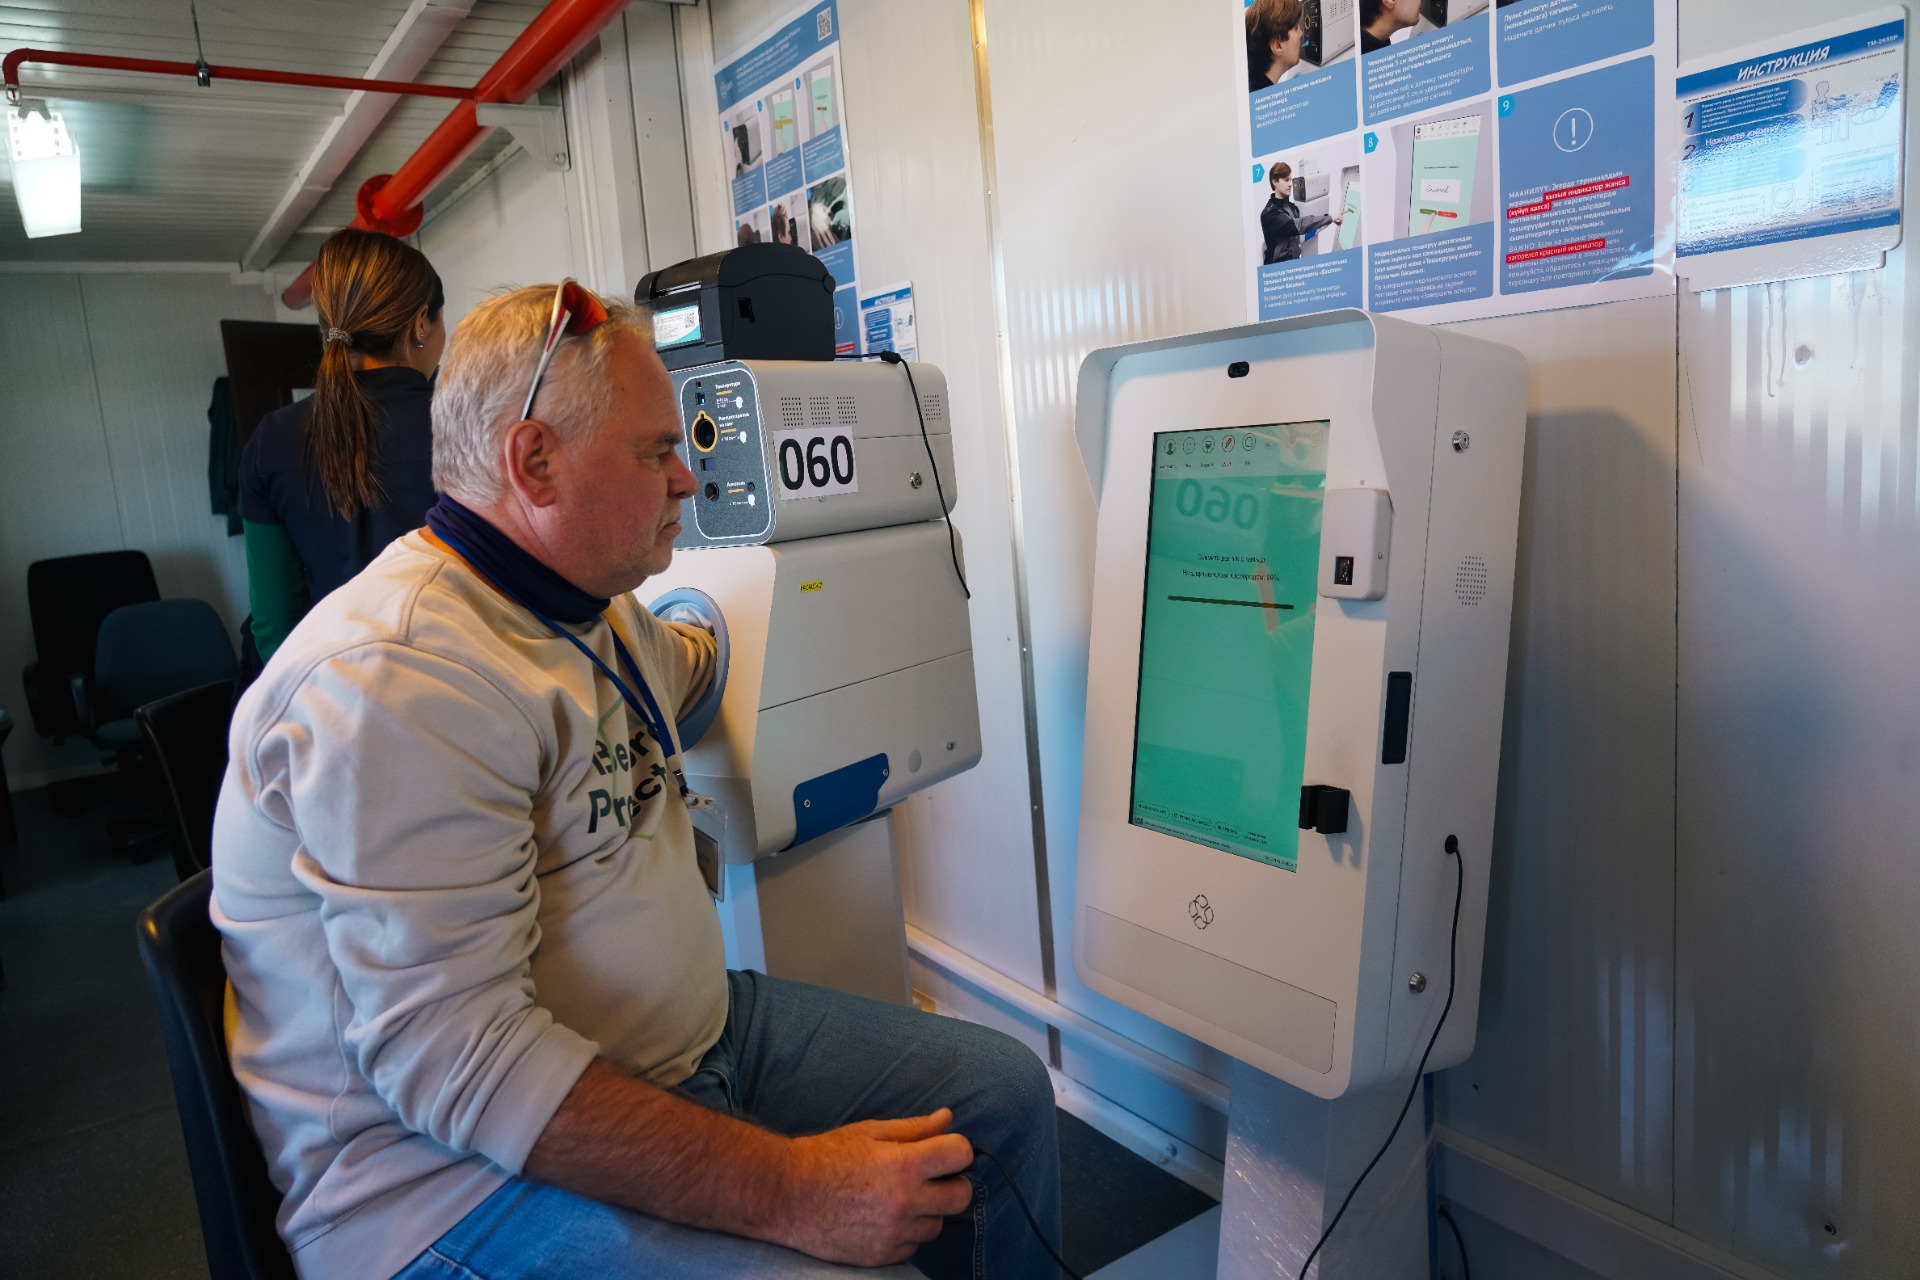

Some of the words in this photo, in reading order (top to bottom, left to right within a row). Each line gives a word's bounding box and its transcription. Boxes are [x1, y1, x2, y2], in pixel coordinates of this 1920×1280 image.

[1737, 45, 1830, 82] ИНСТРУКЦИЯ
[1502, 100, 1510, 112] 9
[1684, 111, 1694, 129] 1
[1368, 137, 1374, 148] 8
[1682, 143, 1697, 161] 2
[1256, 168, 1261, 178] 7
[1568, 184, 1602, 197] индикатор
[1540, 247, 1566, 257] красный
[1568, 241, 1602, 253] индикатор
[779, 434, 855, 491] 060
